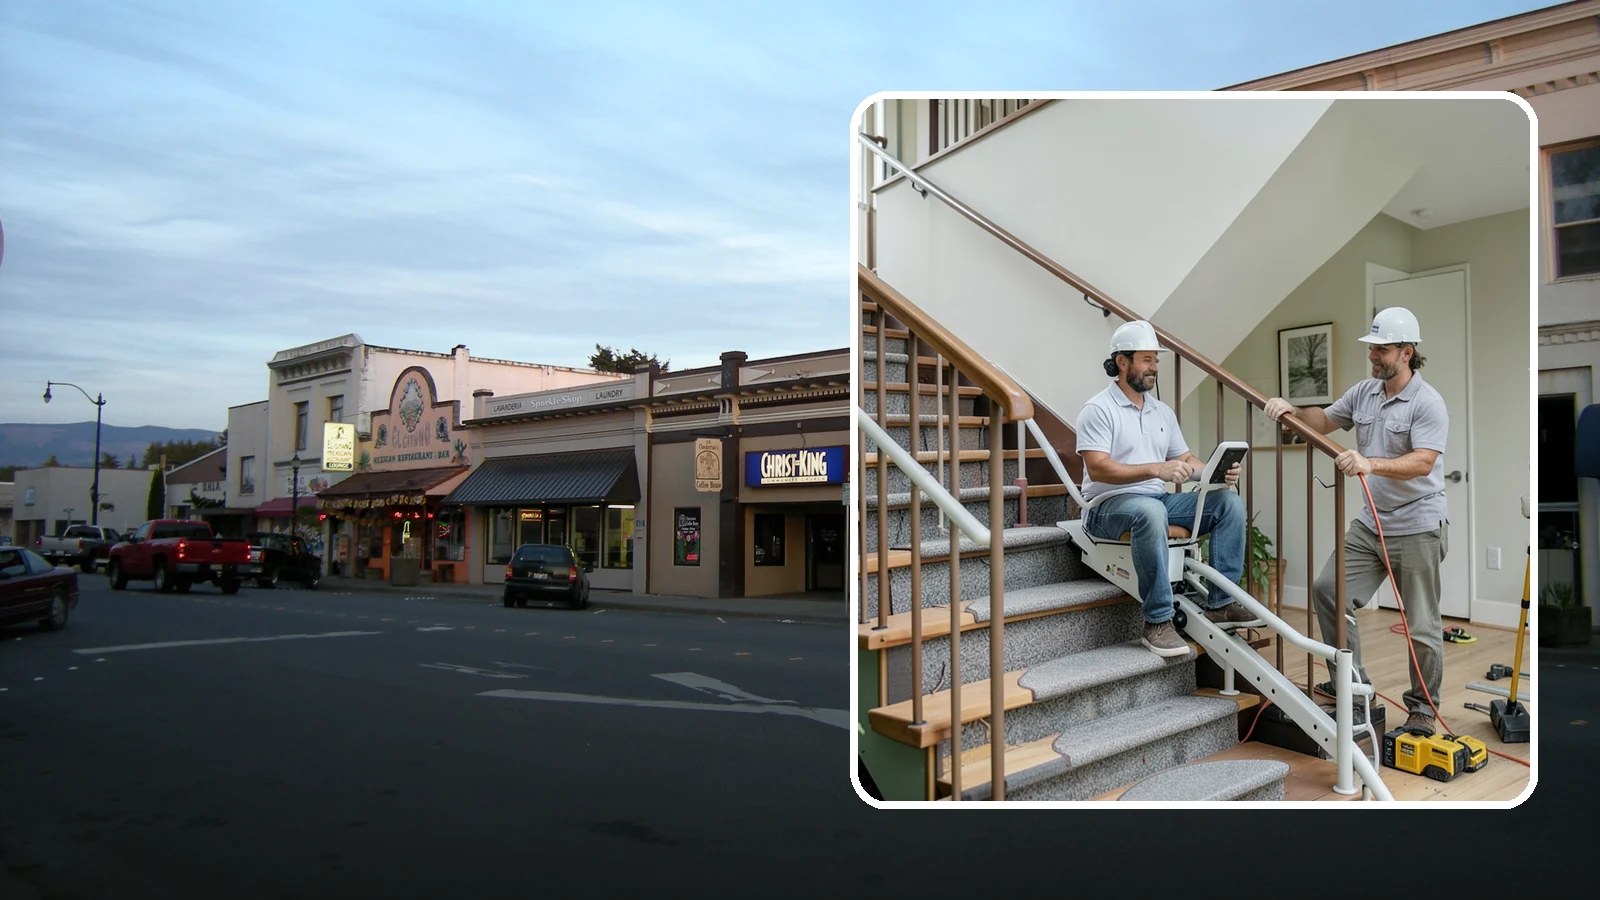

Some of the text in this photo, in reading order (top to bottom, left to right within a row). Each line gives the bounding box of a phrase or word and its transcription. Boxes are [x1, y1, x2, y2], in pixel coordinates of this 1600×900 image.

[595, 389, 624, 400] LAUNDRY
[493, 402, 523, 413] LAVANDERIA
[530, 394, 583, 410] Sparkle Shop
[373, 455, 396, 464] MEXICAN
[397, 452, 433, 462] RESTAURANT
[438, 450, 450, 459] BAR
[761, 452, 797, 478] CHRIST
[800, 450, 828, 477] KING
